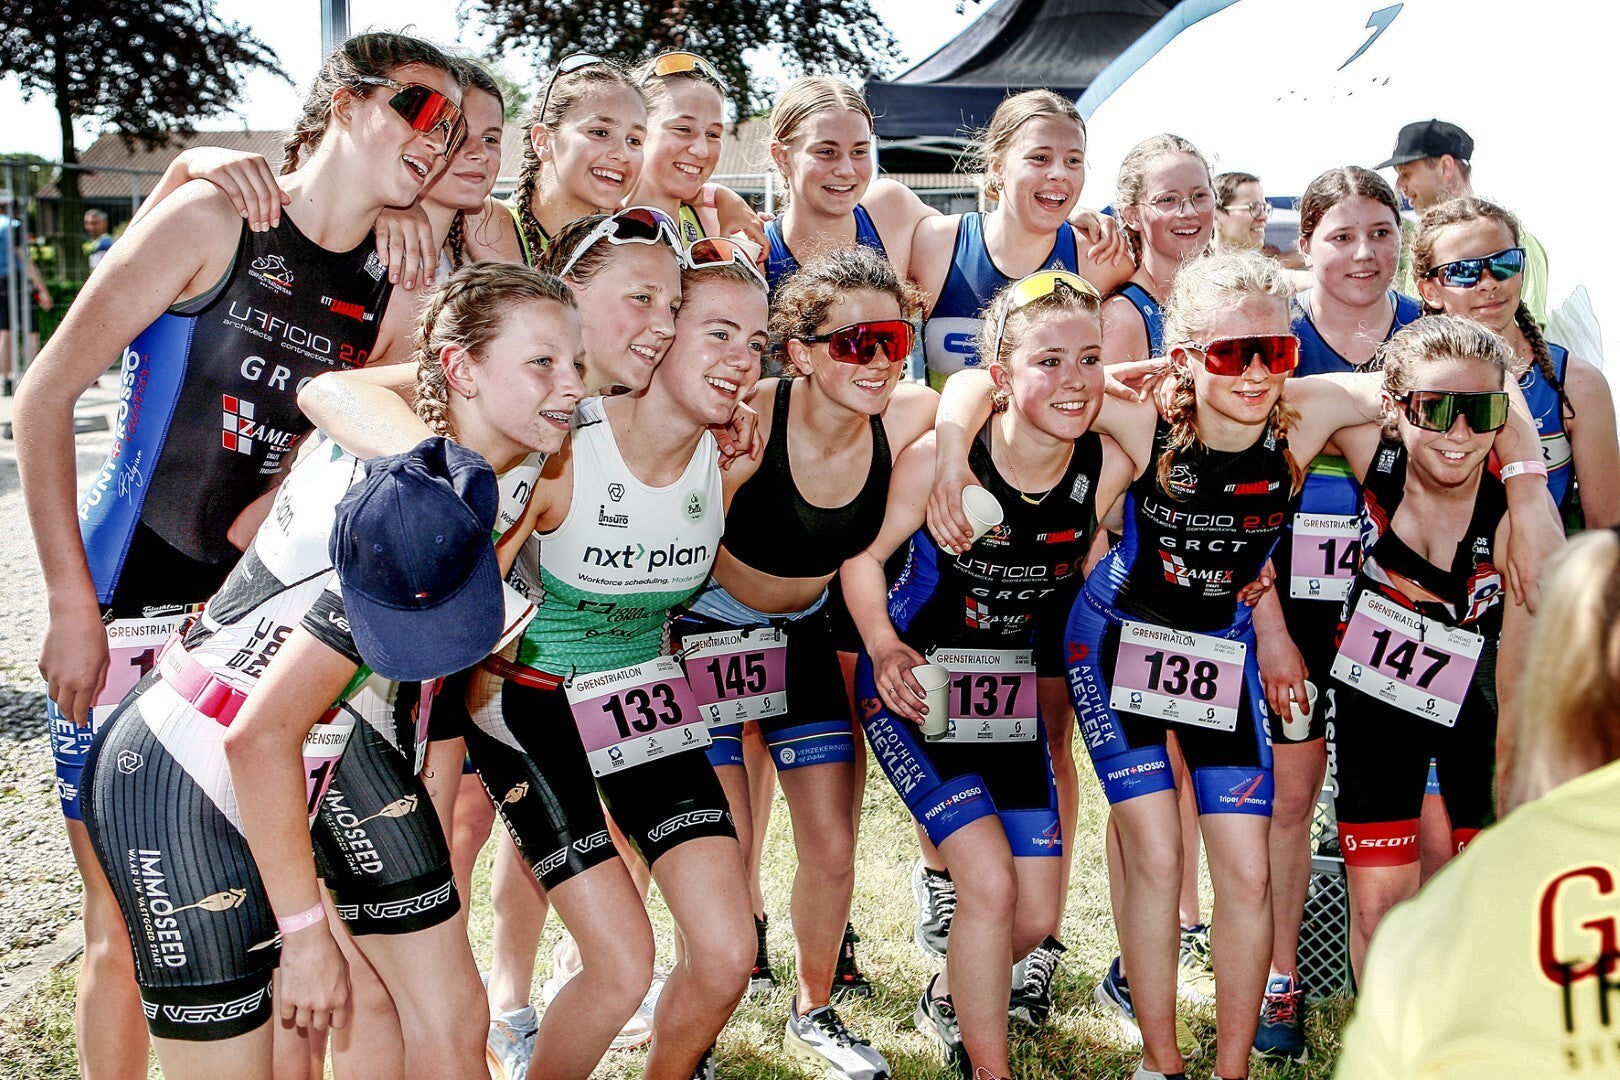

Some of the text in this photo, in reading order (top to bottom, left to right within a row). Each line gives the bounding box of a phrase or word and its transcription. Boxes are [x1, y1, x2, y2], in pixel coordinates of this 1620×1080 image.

[222, 319, 335, 366] architects contractors
[115, 350, 140, 440] ROSSO
[238, 418, 302, 447] ZAMEX
[78, 458, 117, 522] PUNT
[1242, 511, 1284, 529] 2.0
[1174, 564, 1234, 582] ZAMEX
[1319, 538, 1362, 577] 14
[577, 572, 624, 586] Workforce
[624, 576, 670, 587] scheduling.
[1367, 599, 1430, 634] GRENSTRIATLON
[1131, 626, 1197, 648] GRENSTRIATLON
[706, 652, 767, 699] 145
[936, 654, 1001, 665] GRENSTRIATLON
[1143, 650, 1220, 702] 138
[1368, 627, 1453, 690] 147
[576, 666, 643, 693] GRENSTRIATLON
[952, 674, 1022, 717] 137
[601, 683, 684, 740] 133
[1068, 666, 1105, 750] HEYLEN
[1081, 664, 1117, 743] APOTHEEK
[867, 721, 917, 795] HEYLEN
[877, 717, 927, 783] APOTHEEK
[1107, 760, 1166, 781] PUNT ROSSO
[924, 786, 982, 821] PUNT ROSSO
[647, 808, 724, 843] VERGE
[1358, 834, 1417, 848] SCOTT
[344, 853, 363, 877] START
[127, 848, 164, 969] WAAR UW VASTGOED START
[138, 849, 188, 968] IMMOSEED
[363, 880, 451, 919] VERGE
[162, 987, 266, 1024] VERGE
